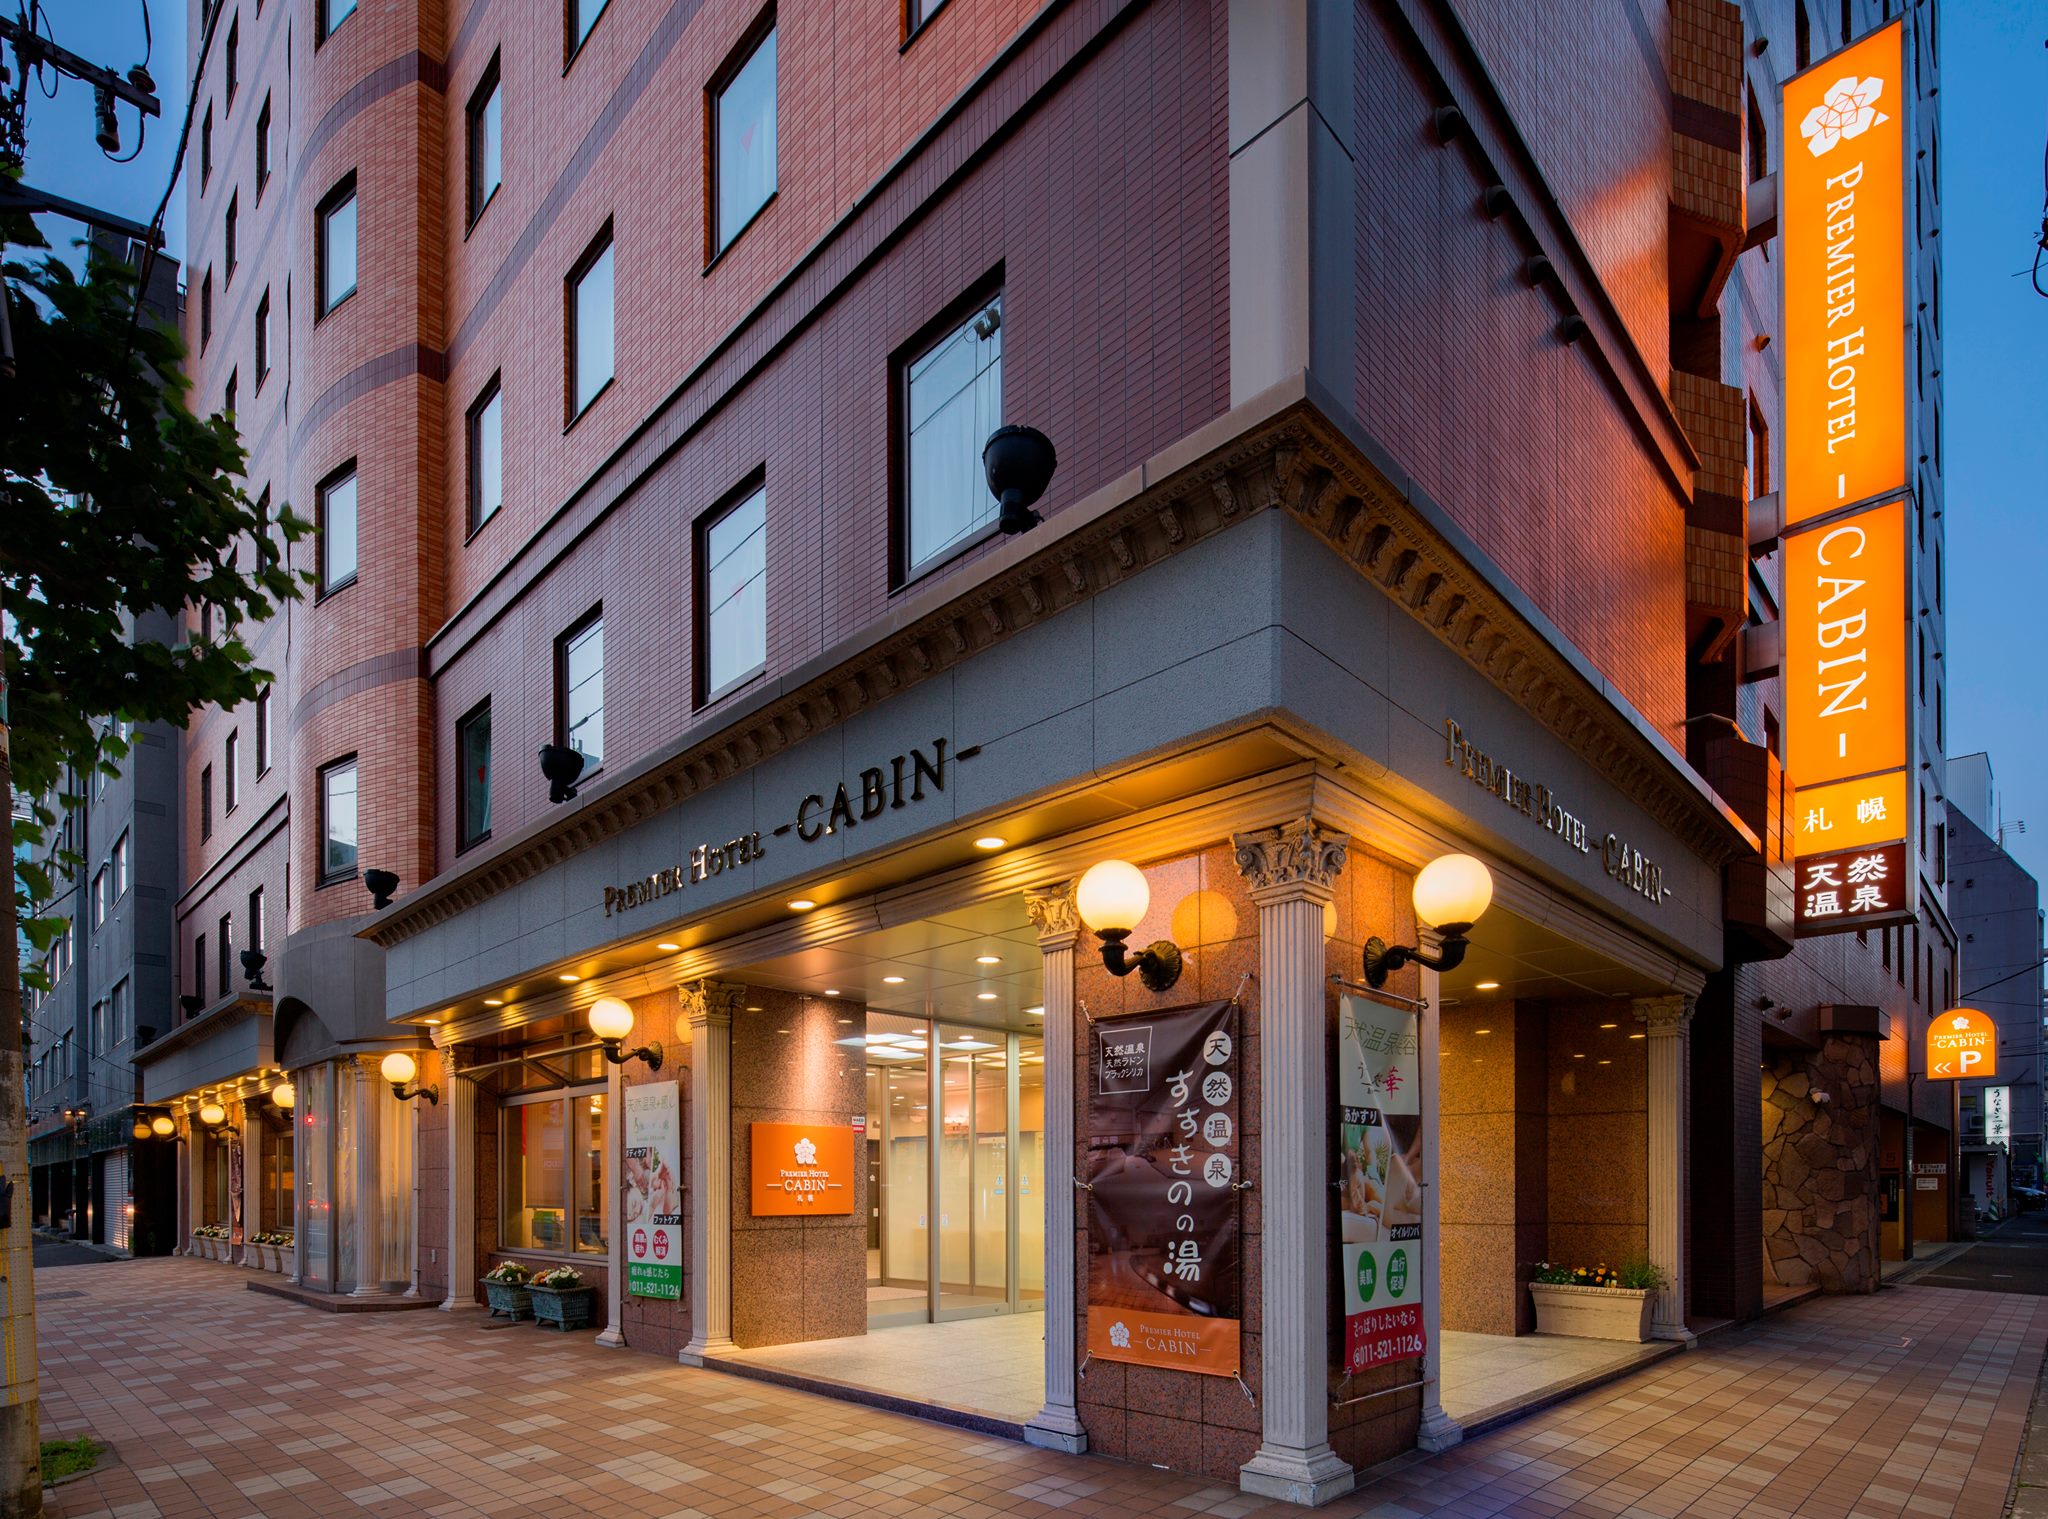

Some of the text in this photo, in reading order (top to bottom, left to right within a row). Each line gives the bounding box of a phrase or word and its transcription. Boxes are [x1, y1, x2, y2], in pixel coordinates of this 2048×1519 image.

[1825, 160, 1864, 328] PREMIER
[1826, 325, 1865, 455] HOTEL
[1445, 718, 1533, 817] PREMIER
[1536, 783, 1589, 854] HOTEL
[1802, 795, 1888, 834] 札幌
[603, 863, 685, 917] PREMIER
[689, 831, 765, 884] HOTEL
[1803, 853, 1889, 891] 天然
[1803, 884, 1889, 918] 温泉
[1105, 1042, 1146, 1057] 天然温泉
[1934, 1033, 1964, 1041] PREMIER
[1104, 1067, 1144, 1080] ブラックシリカ
[1105, 1056, 1144, 1069] 天然ラドン
[1959, 1050, 1982, 1074] P
[1205, 1034, 1230, 1181] 天然温泉
[1344, 1107, 1378, 1125] あかすり
[779, 1168, 829, 1179] PREMIER HOTEL
[1162, 1069, 1203, 1282] すすきのの湯
[1985, 1159, 1995, 1199] Yakult
[653, 1215, 680, 1225] フットケア
[1391, 1258, 1406, 1273] 血行
[631, 1280, 680, 1297] 011-521-1126
[1139, 1323, 1201, 1340] PREMIER HOTEL
[1353, 1309, 1417, 1338] さっぱりしたいなら
[1360, 1334, 1423, 1365] 011-521-1126
